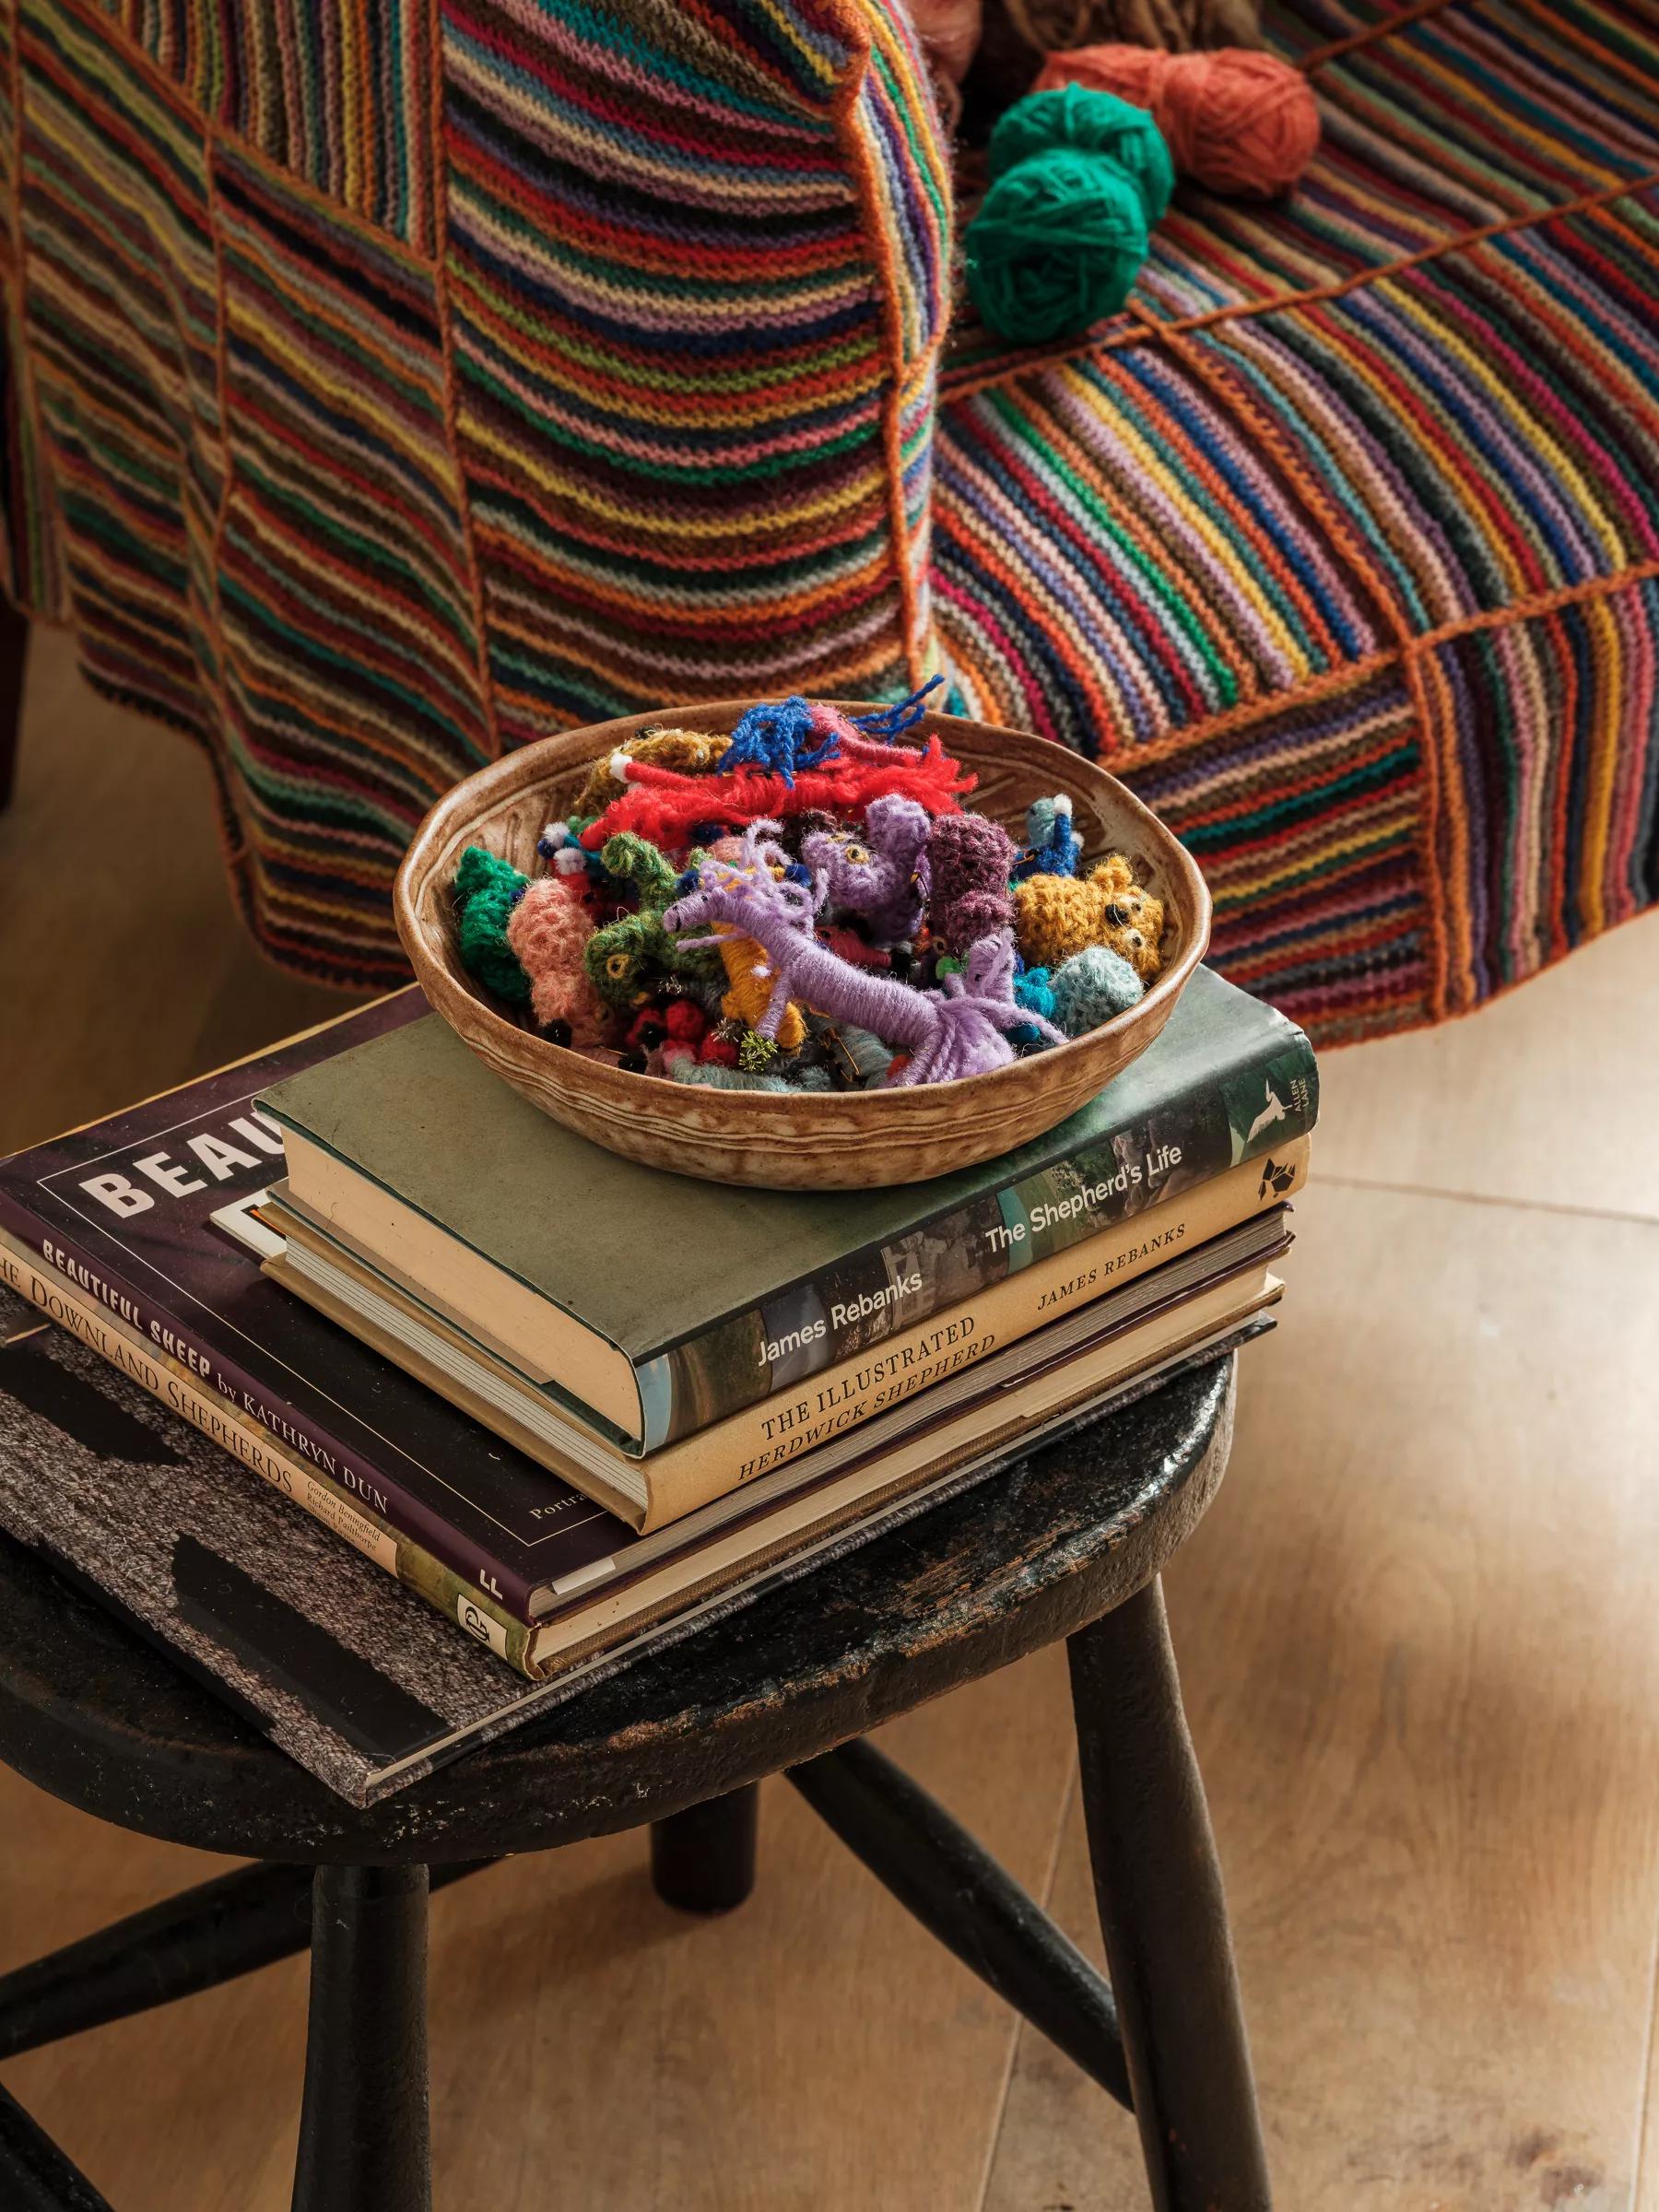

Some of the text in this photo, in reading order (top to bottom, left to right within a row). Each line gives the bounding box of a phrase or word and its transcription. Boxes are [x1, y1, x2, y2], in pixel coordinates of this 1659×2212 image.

[1290, 1079, 1302, 1112] ALLEN
[1299, 1077, 1310, 1107] LANE
[985, 1146, 1182, 1253] The Shepherd's Life
[1037, 1224, 1186, 1311] JAMES REBANKS
[758, 1273, 923, 1367] James Rebanks
[30, 1275, 159, 1390] DOWNLAND
[168, 1381, 292, 1492] SHEPHERDS
[42, 1239, 388, 1513] BEAUTIFUL SHEEP by KATHRYN DUN
[738, 1334, 996, 1480] HERDWICK SHEPHERD
[761, 1316, 975, 1441] THE ILLUSTRATED
[307, 1493, 335, 1519] Richard
[307, 1481, 336, 1508] Gordon
[338, 1504, 382, 1542] Beningfield
